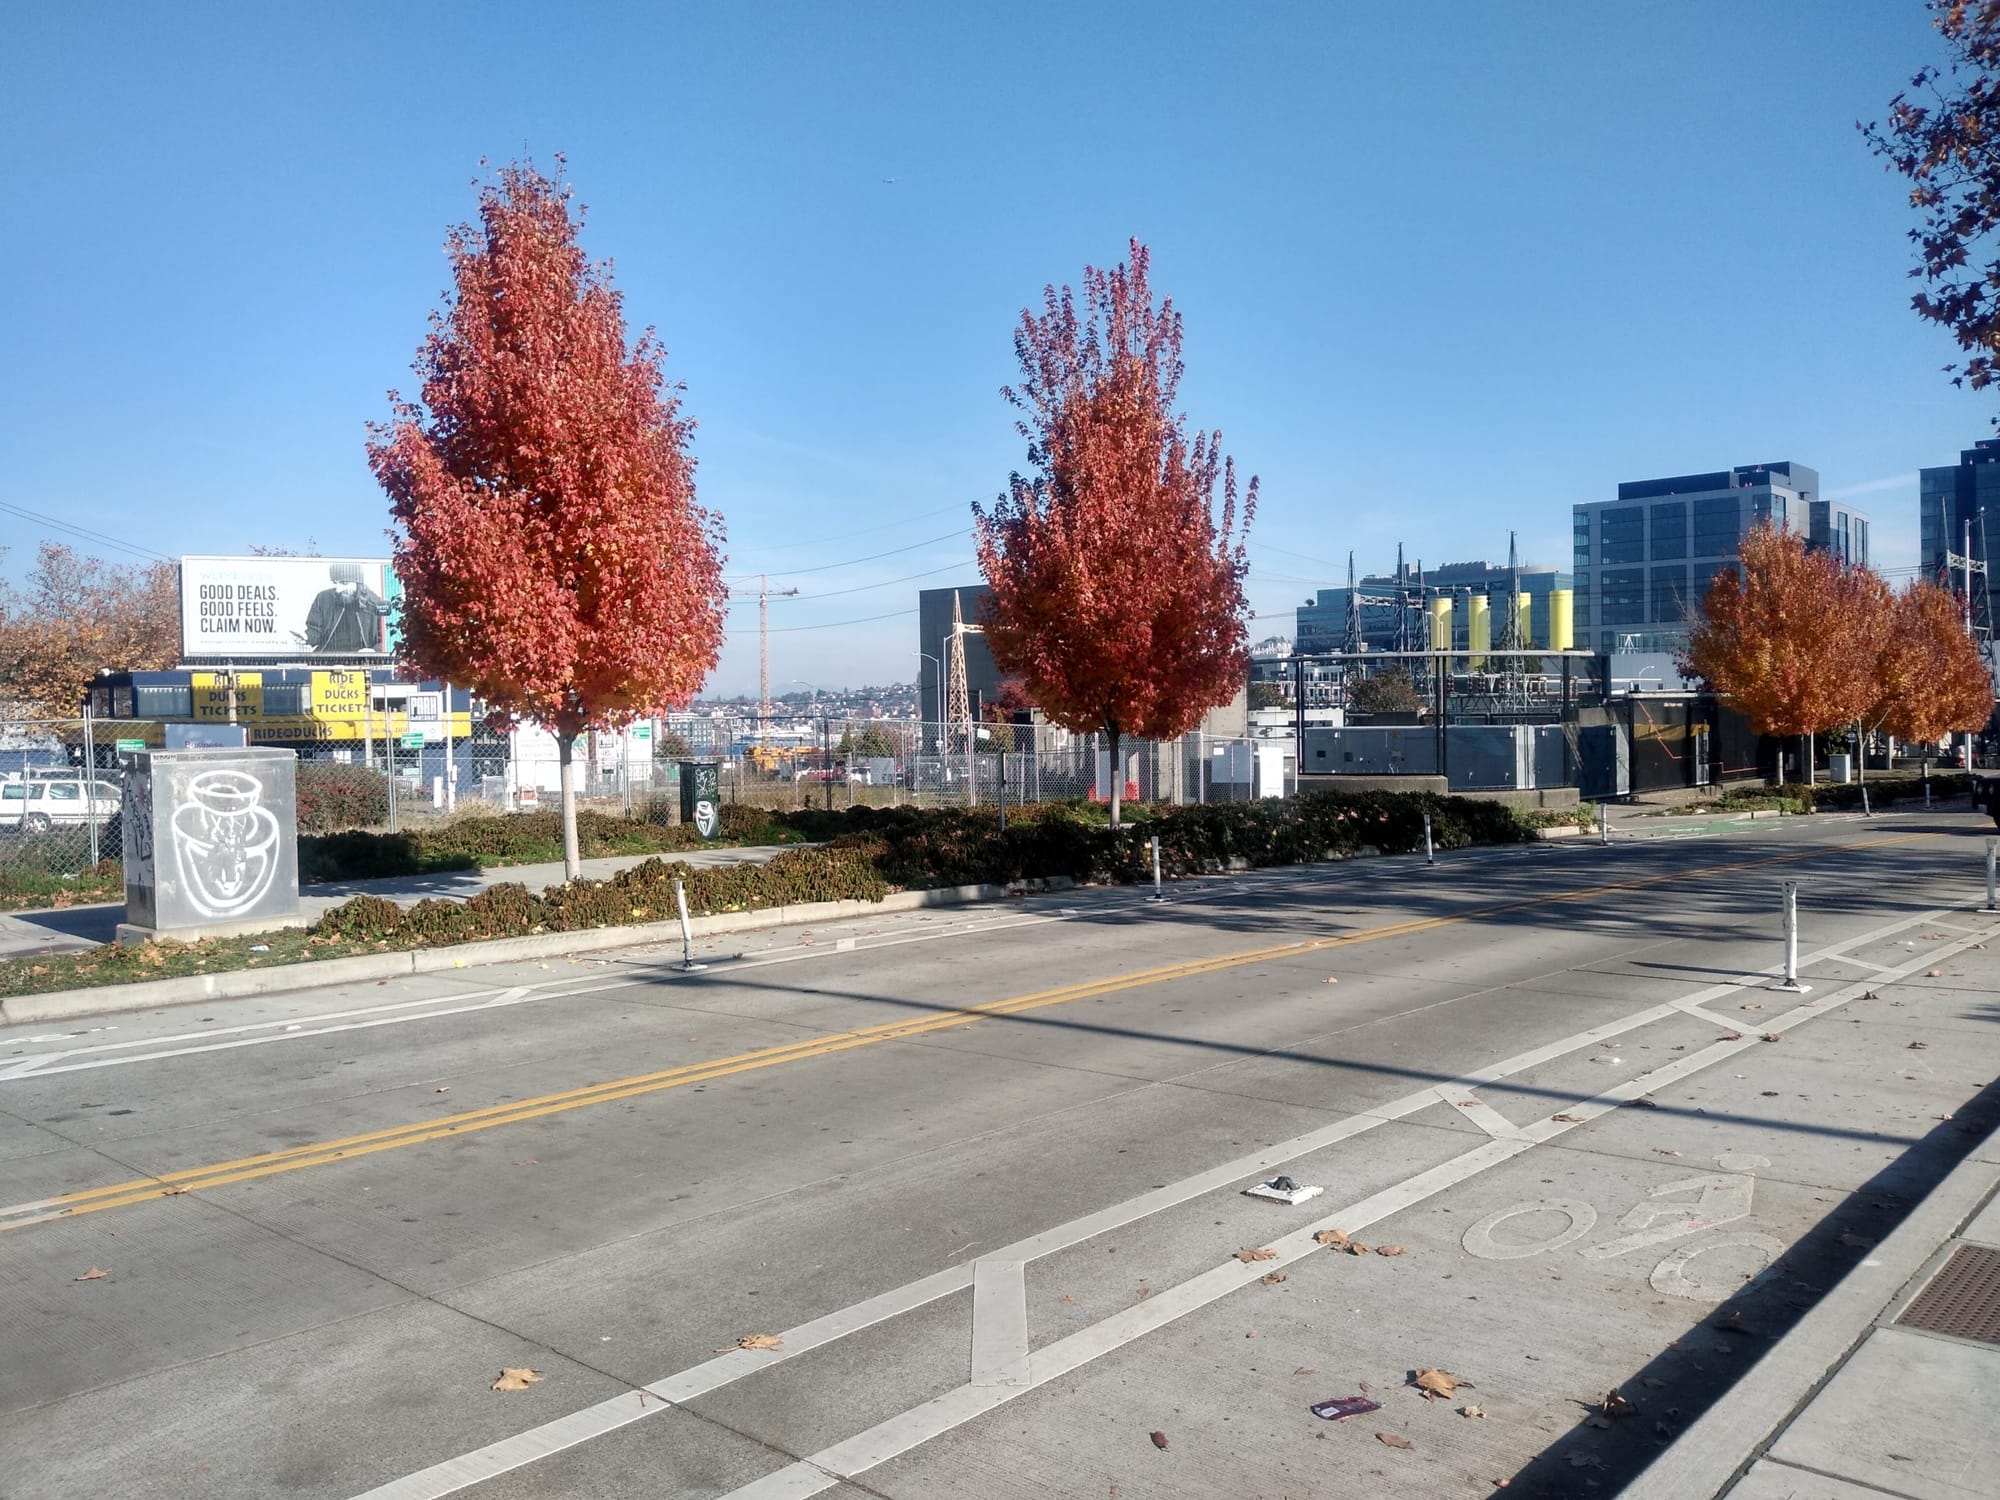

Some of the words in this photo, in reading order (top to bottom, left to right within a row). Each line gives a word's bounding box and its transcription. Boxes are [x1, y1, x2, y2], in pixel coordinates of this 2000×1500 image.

[199, 584, 233, 600] GOOD
[237, 585, 280, 601] DEALS.
[200, 601, 234, 616] GOOD
[238, 601, 278, 617] FEELS.
[200, 618, 240, 633] CLAIM
[244, 618, 278, 634] NOW.
[329, 674, 354, 684] RIDE
[325, 689, 359, 699] DUCKS
[254, 728, 283, 739] RIDE
